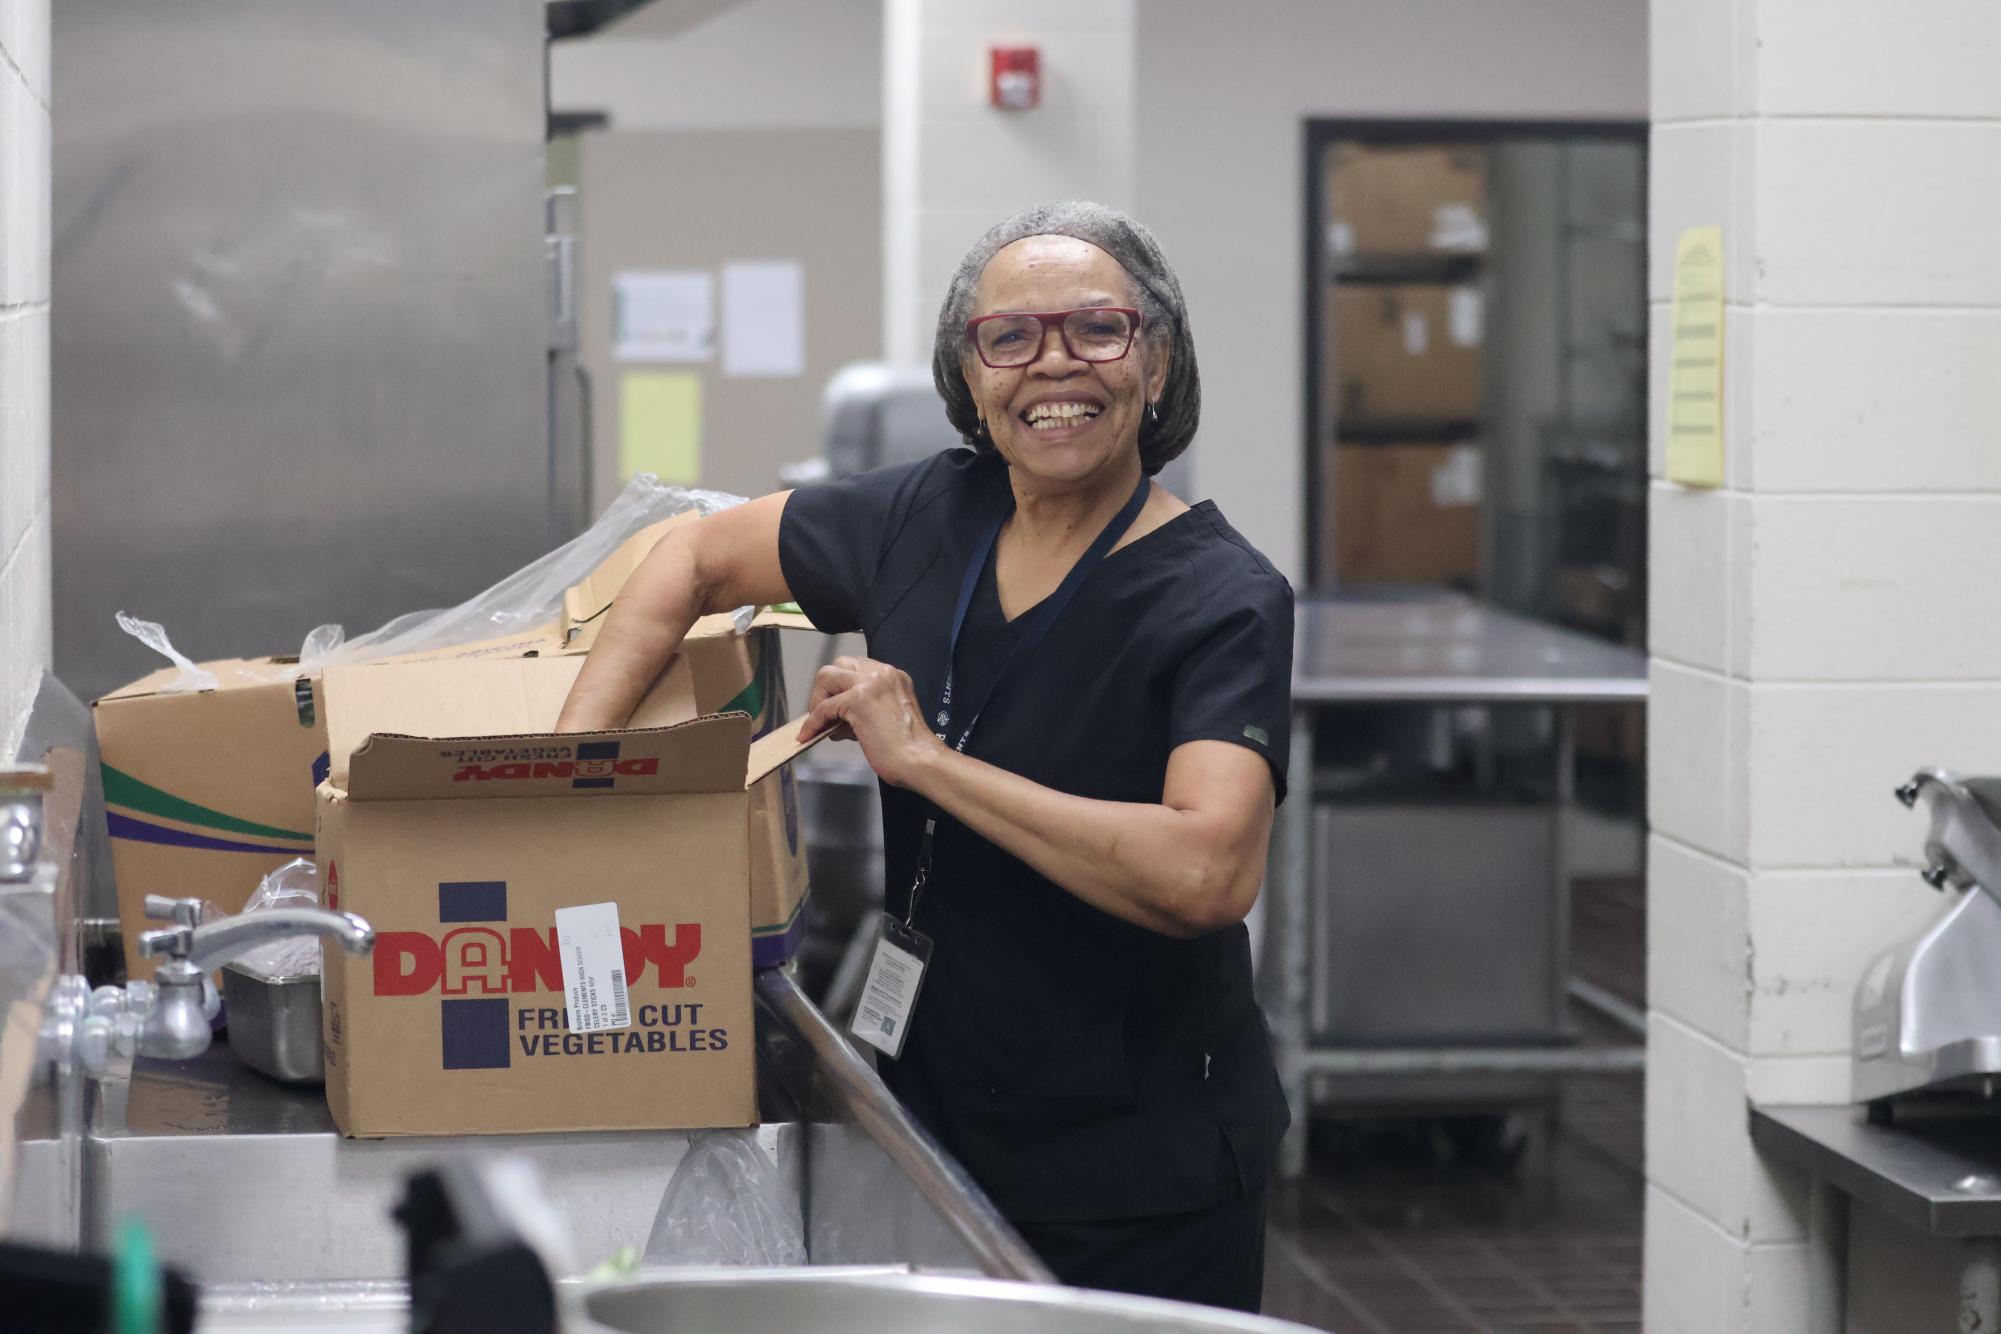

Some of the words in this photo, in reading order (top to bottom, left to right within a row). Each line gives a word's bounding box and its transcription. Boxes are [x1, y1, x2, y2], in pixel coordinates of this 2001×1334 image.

[453, 758, 659, 782] DANDY
[580, 981, 589, 1009] CLEMENTS
[590, 988, 598, 1008] STICKS
[592, 1009, 600, 1029] CELERY
[639, 1004, 703, 1027] CUT
[520, 1029, 728, 1056] VEGETABLES
